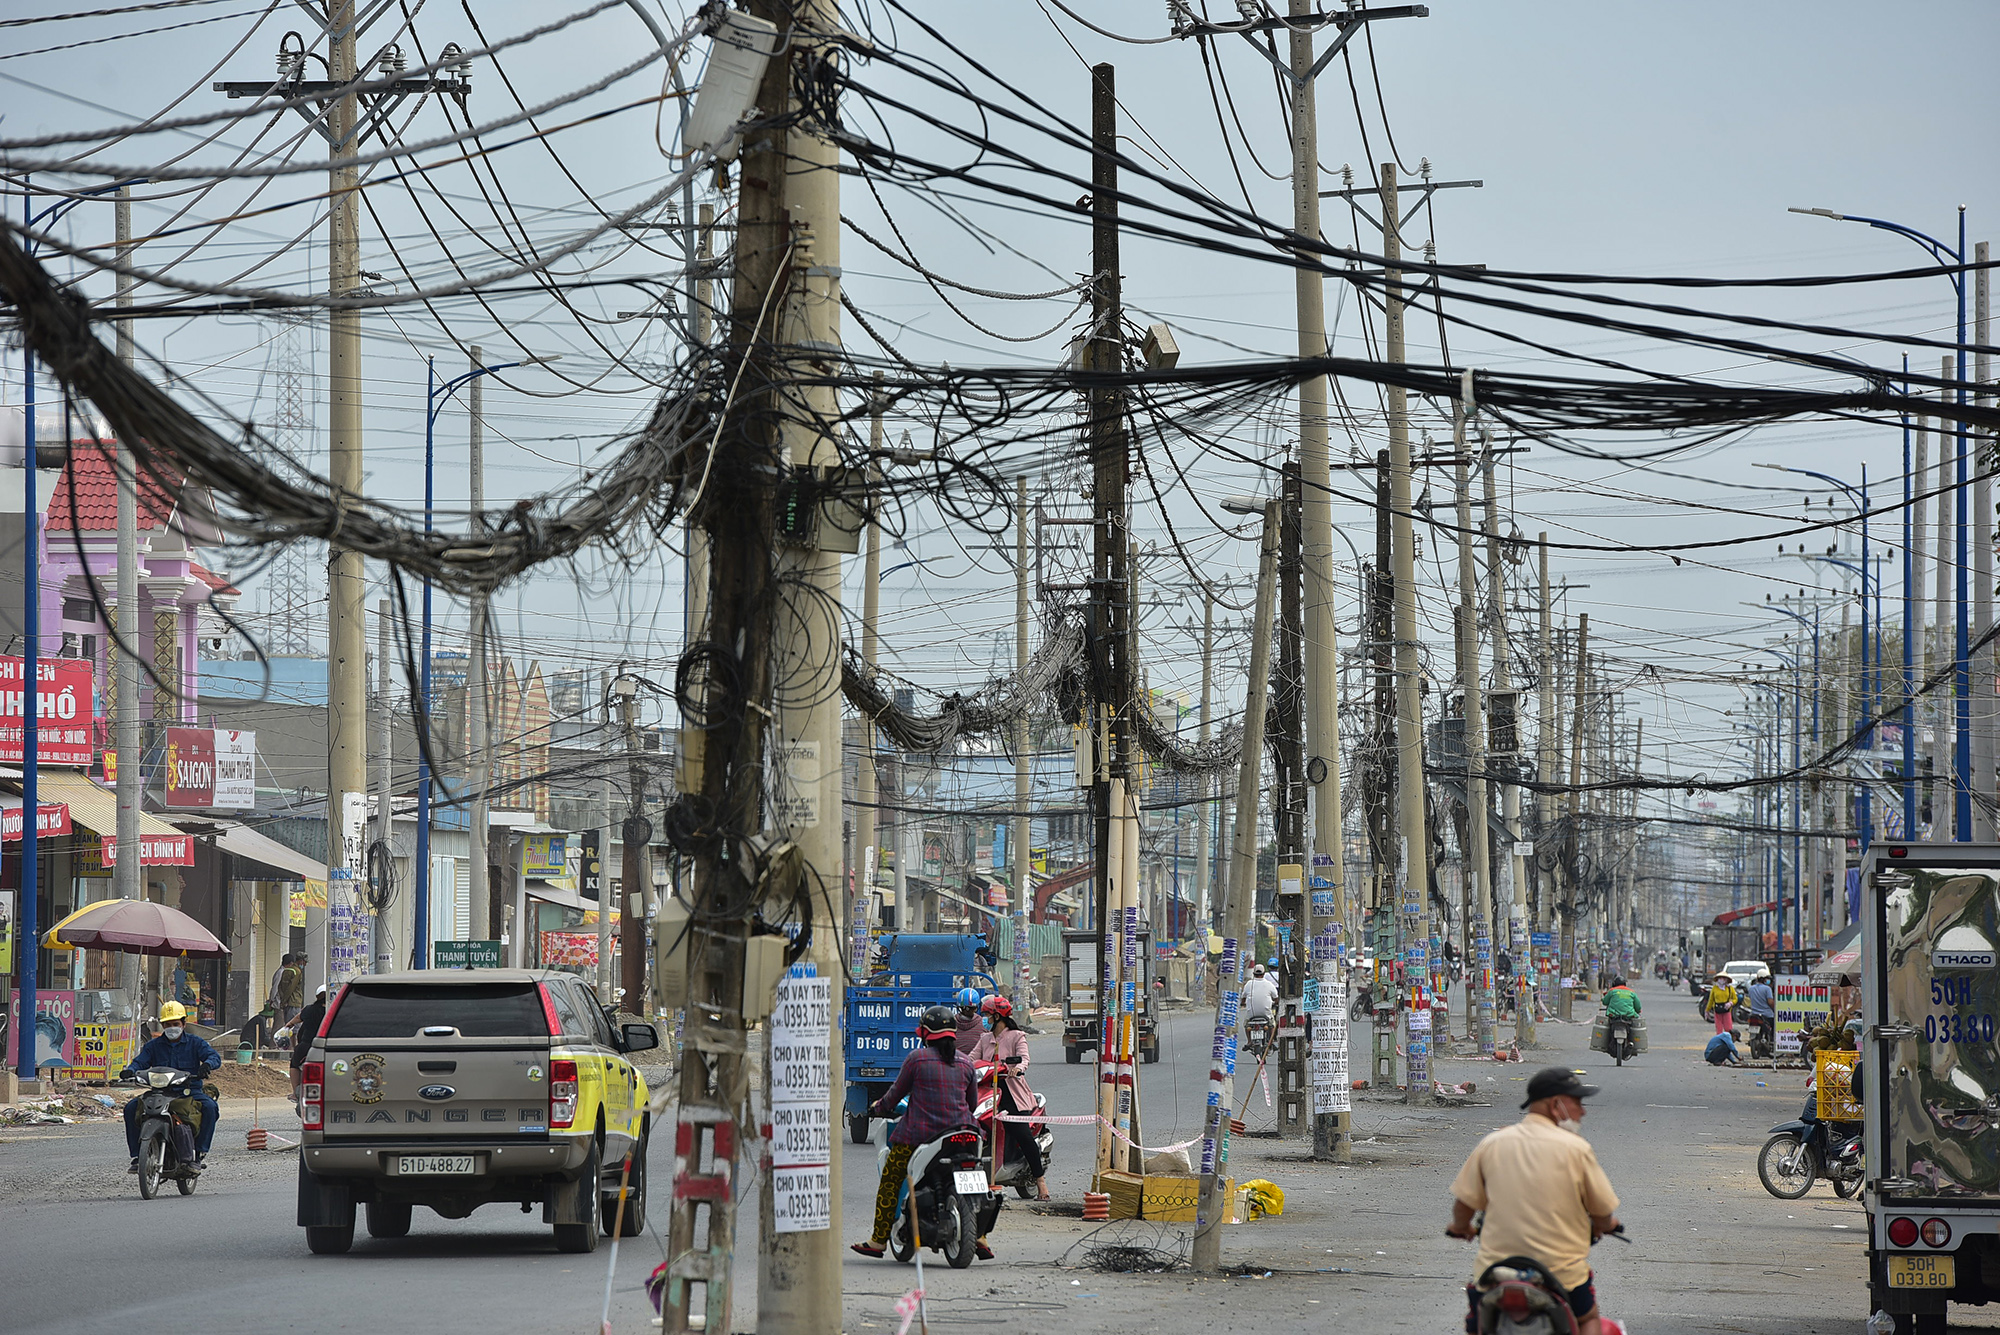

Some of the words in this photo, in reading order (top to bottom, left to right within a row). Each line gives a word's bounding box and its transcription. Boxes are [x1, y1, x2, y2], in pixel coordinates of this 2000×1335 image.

[178, 759, 212, 789] SAIGON
[436, 952, 465, 961] THANH
[1938, 955, 1991, 964] THACO
[792, 986, 809, 1000] VAY
[1931, 977, 1971, 1006] 50H
[44, 995, 71, 1018] TÓC
[859, 1003, 890, 1020] NHẬN
[1777, 1008, 1802, 1023] HOÀNH
[1925, 1014, 1993, 1043] 033.80
[794, 1046, 811, 1061] VAY
[426, 1087, 447, 1097] Ford
[330, 1108, 544, 1123] RANGER
[795, 1110, 811, 1124] VAY
[401, 1157, 472, 1174] 51D-488.27
[797, 1175, 813, 1191] VAY
[1907, 1258, 1935, 1271] 50H
[1896, 1272, 1947, 1286] 033.80
